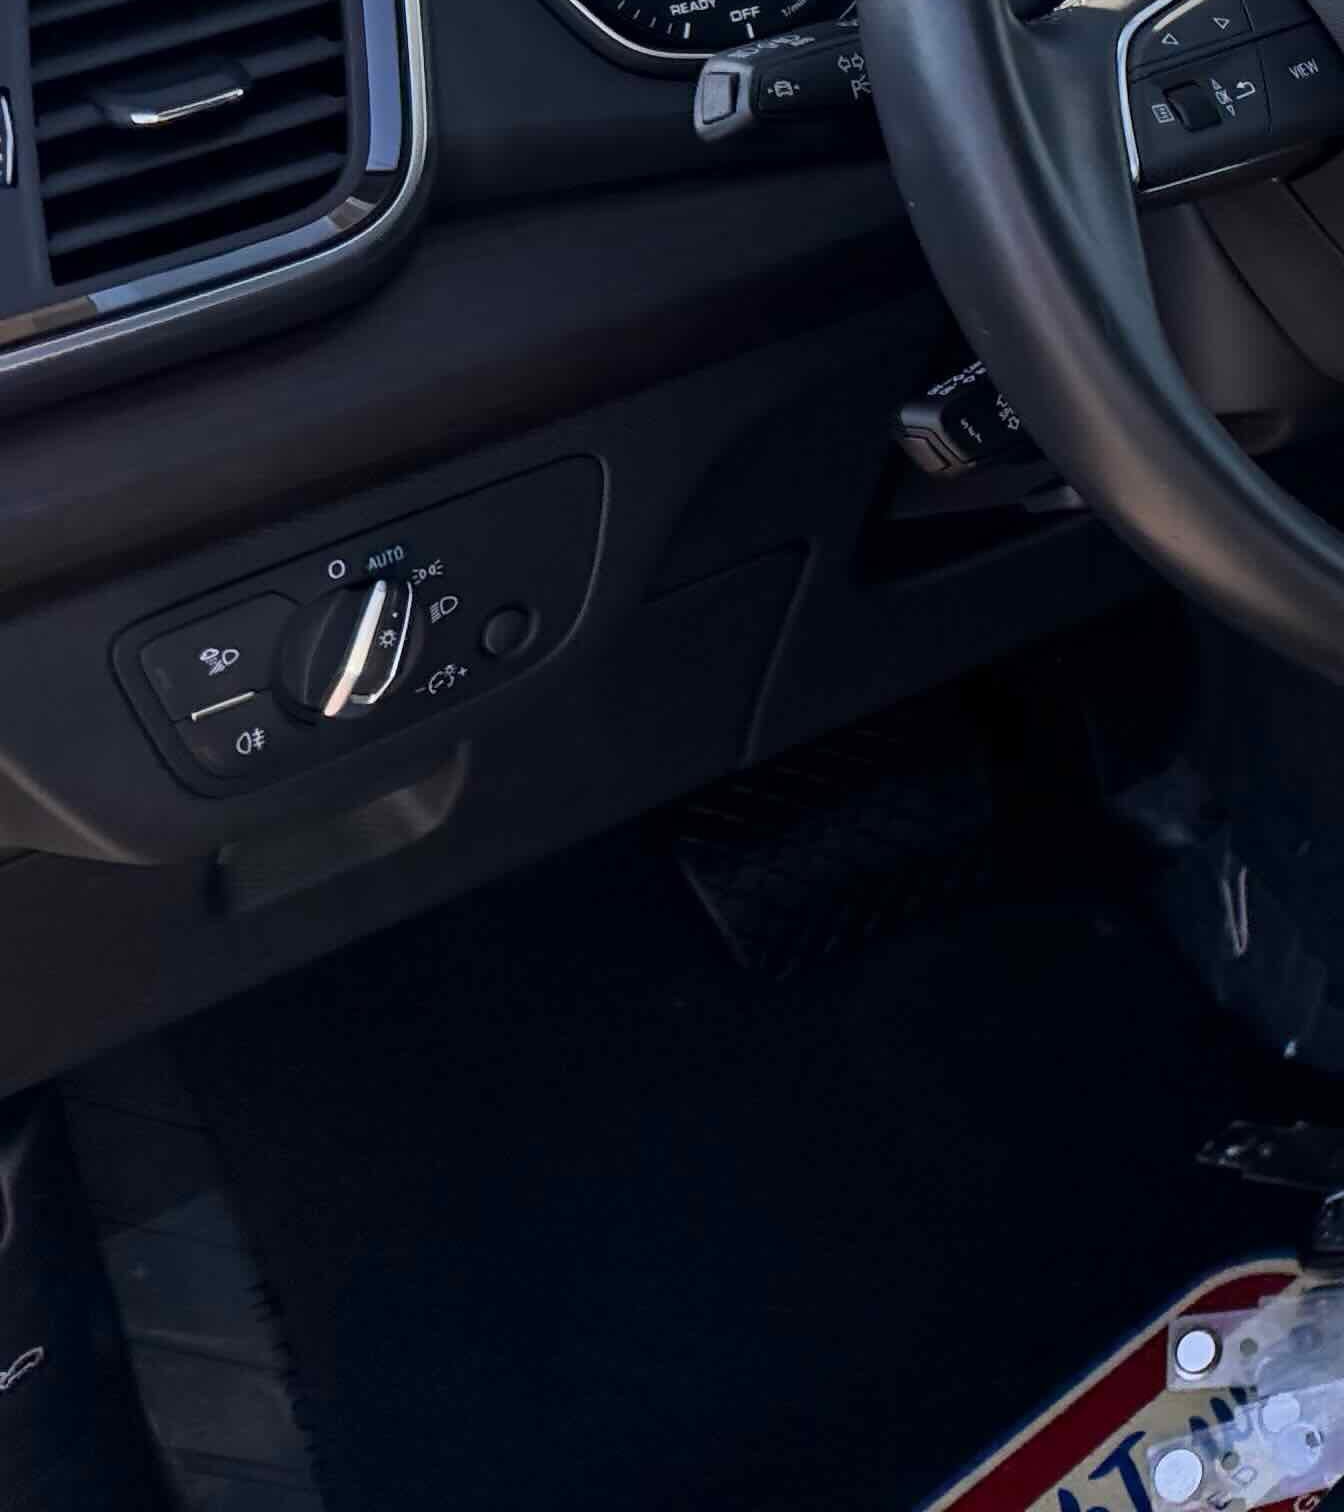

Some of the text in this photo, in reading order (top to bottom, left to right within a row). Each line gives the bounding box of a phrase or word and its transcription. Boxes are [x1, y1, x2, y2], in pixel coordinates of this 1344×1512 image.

[729, 4, 762, 23] OFF
[1287, 56, 1319, 80] VIEW
[367, 544, 405, 569] AUTO
